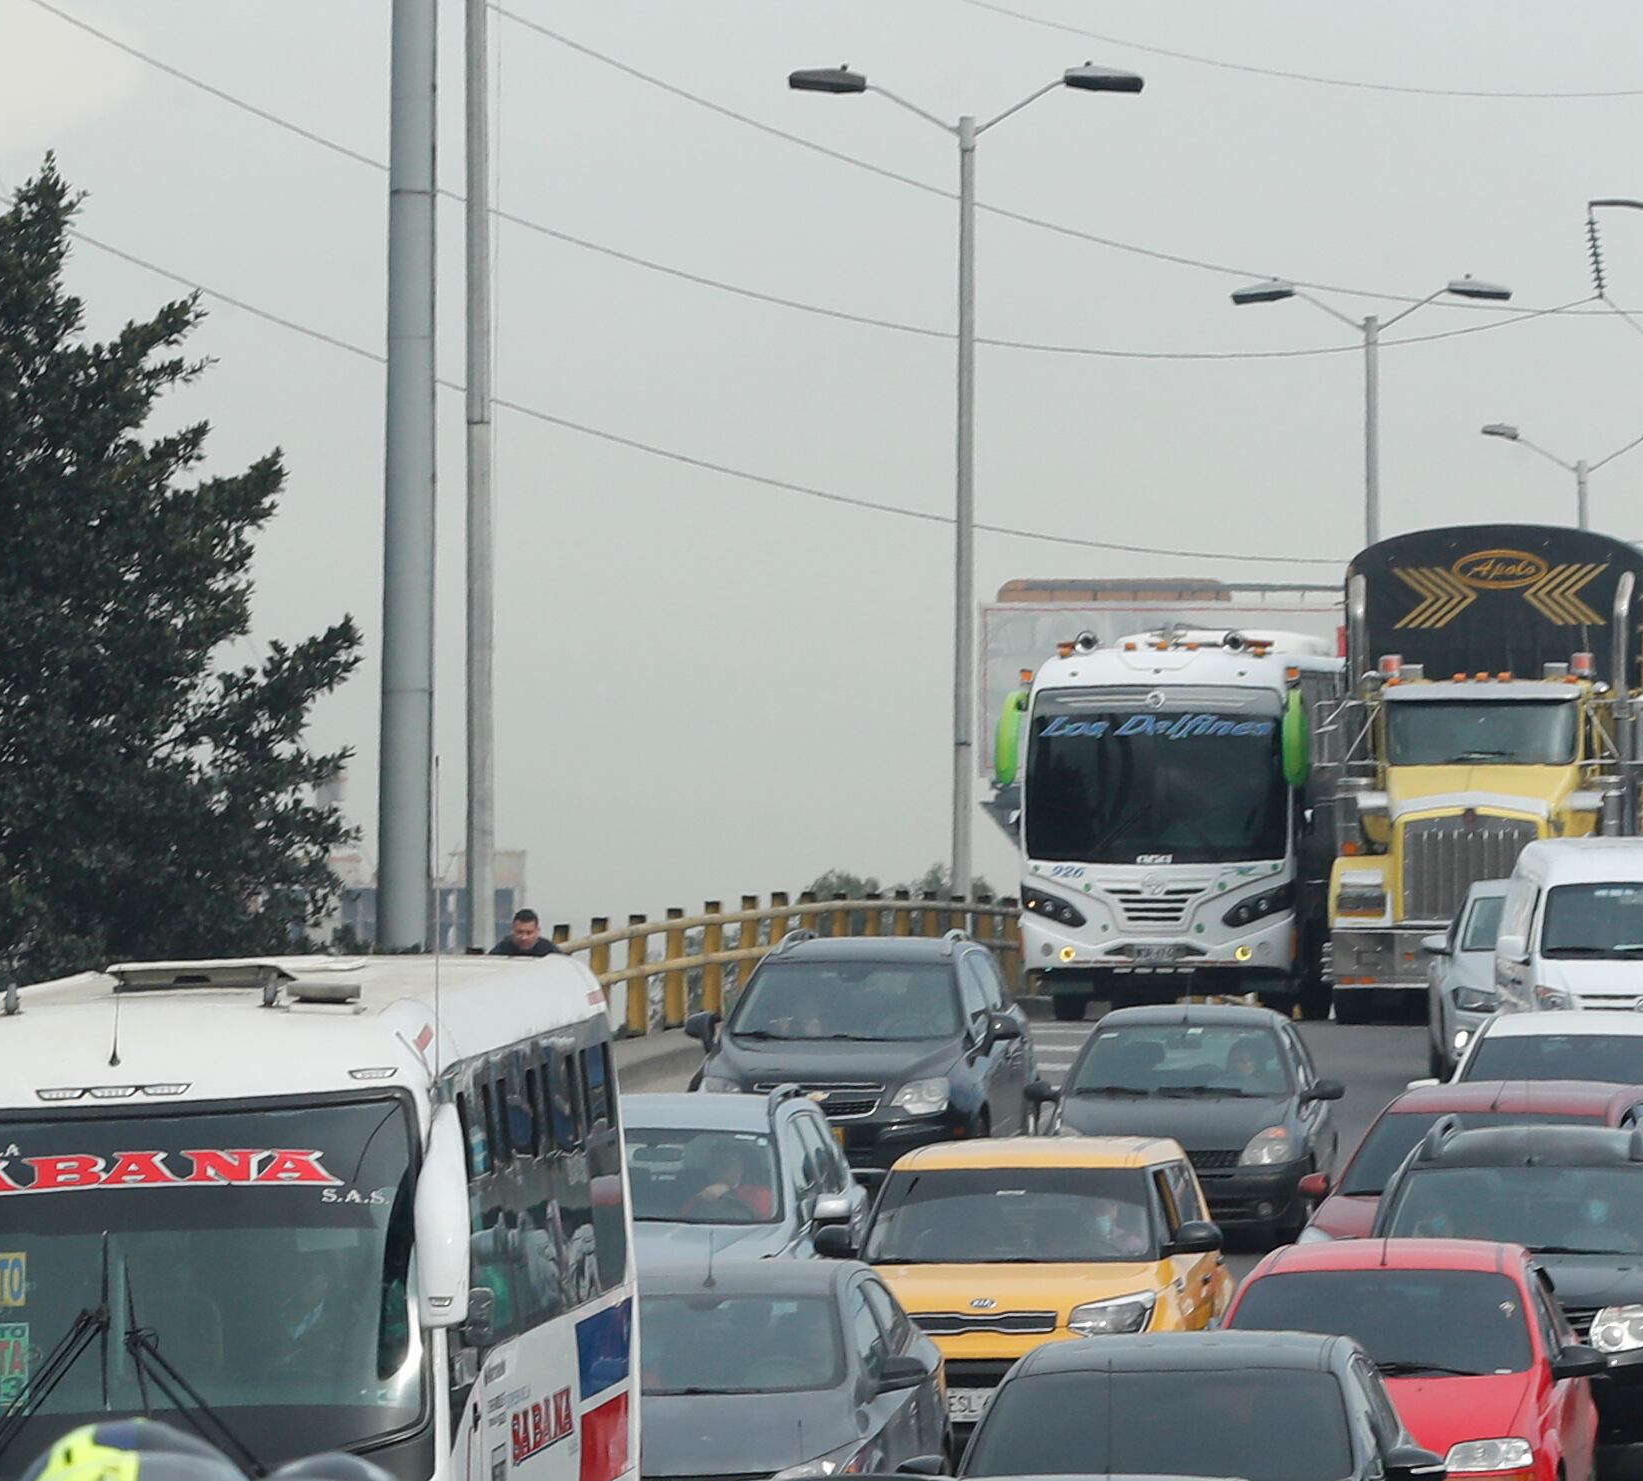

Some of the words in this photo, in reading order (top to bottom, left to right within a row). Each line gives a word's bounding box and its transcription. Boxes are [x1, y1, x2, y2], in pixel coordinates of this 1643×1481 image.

[1464, 558, 1537, 580] Apolo
[1038, 716, 1109, 739] Los
[1113, 714, 1274, 740] Delfines
[1050, 866, 1086, 879] 926
